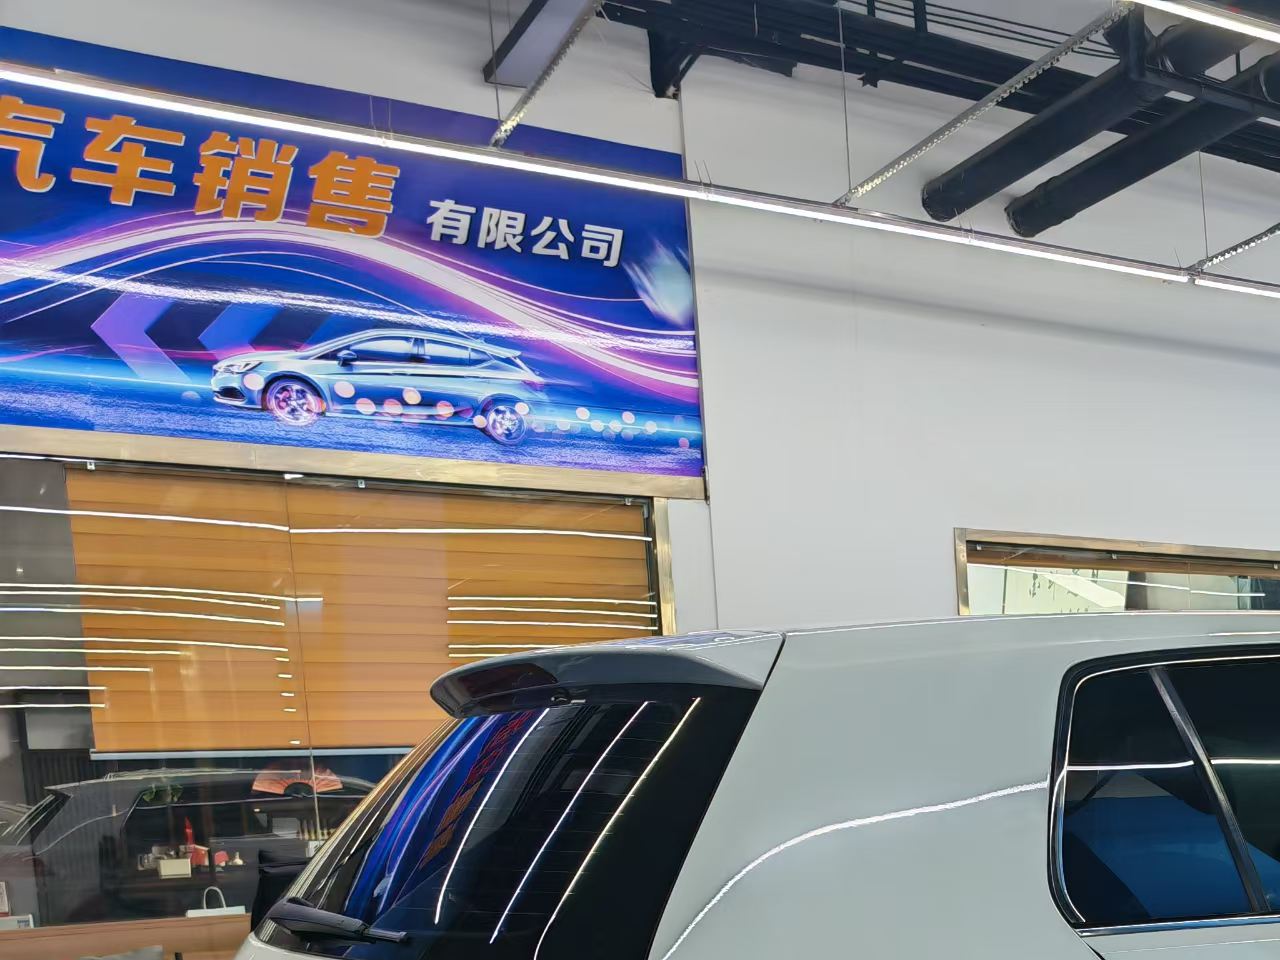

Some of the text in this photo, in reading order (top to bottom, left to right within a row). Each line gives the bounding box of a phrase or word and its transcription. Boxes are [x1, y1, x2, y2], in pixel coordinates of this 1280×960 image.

[0, 94, 624, 268] 汽车销售 有限公司
